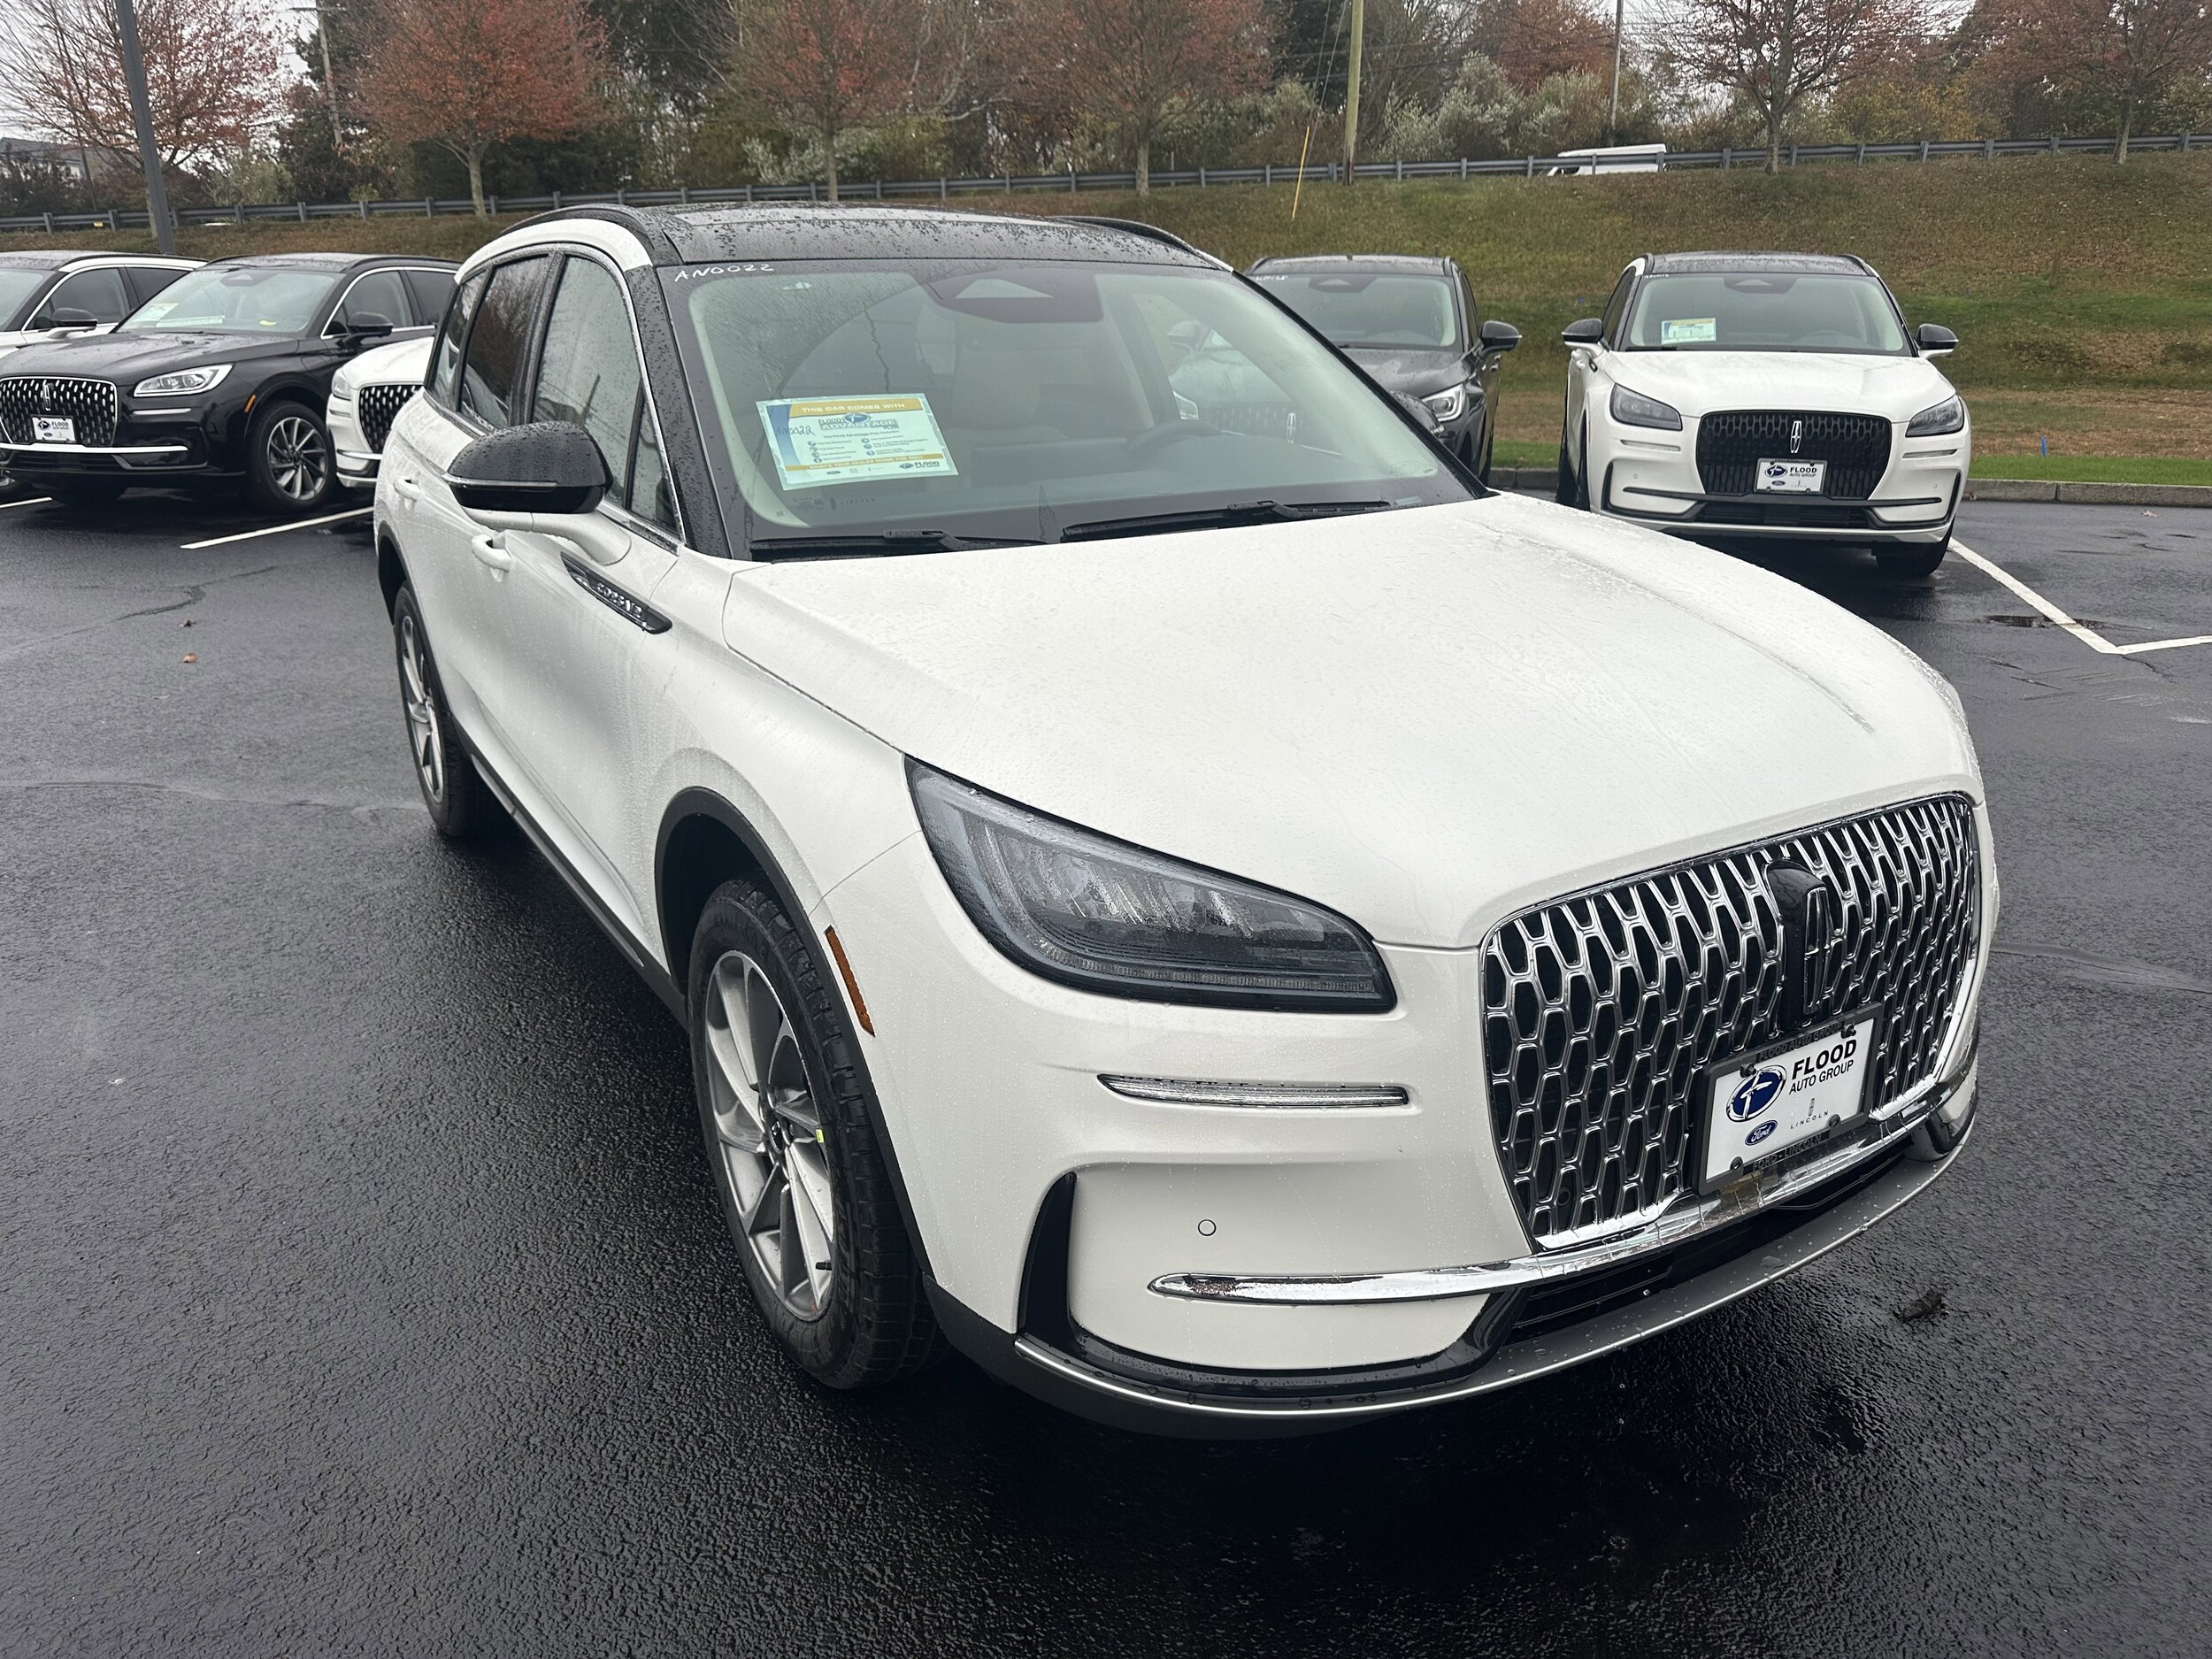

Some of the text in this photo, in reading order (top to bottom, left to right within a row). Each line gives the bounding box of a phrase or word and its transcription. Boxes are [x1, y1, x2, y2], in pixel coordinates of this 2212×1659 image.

[820, 419, 899, 430] ADVANTAGE
[1758, 1022, 1842, 1063] FLOOD AUTO GROUP
[1792, 1039, 1857, 1080] FLOOD
[1788, 1059, 1855, 1096] AUTO GROUP
[1790, 1110, 1829, 1129] LINCOLN
[1784, 1134, 1823, 1157] LINCOLN
